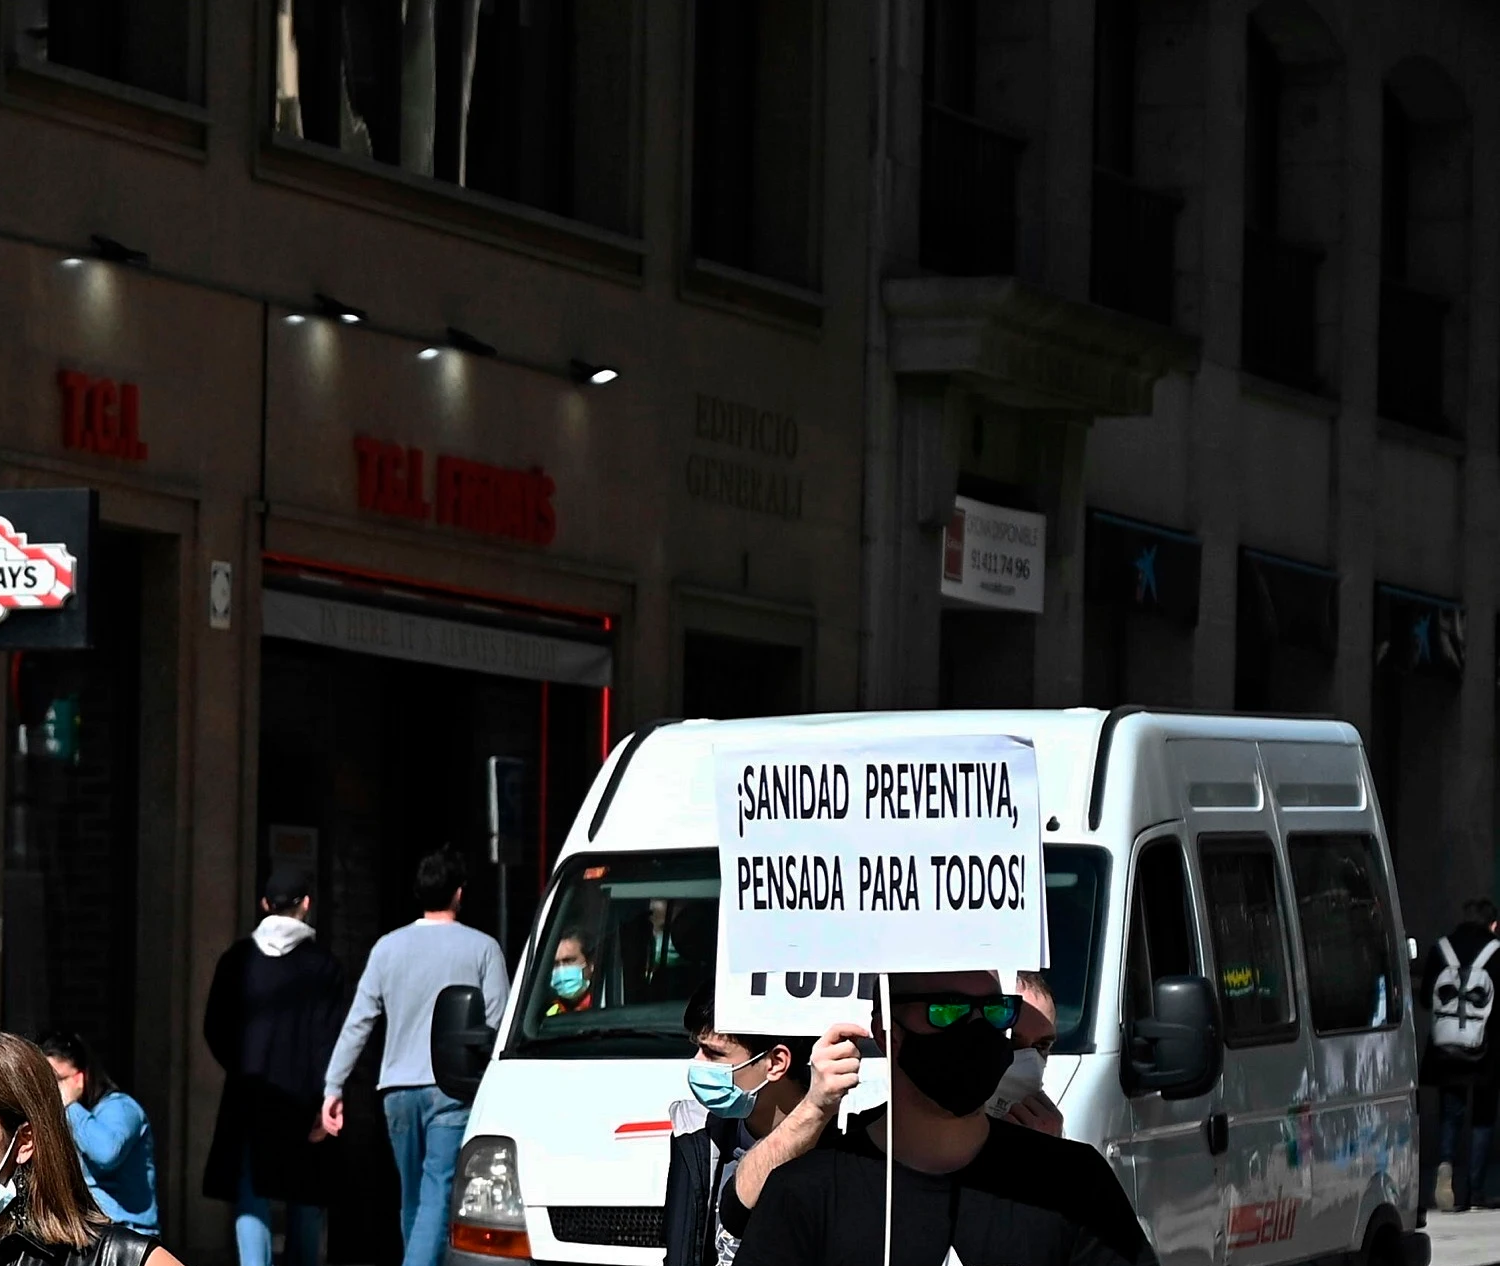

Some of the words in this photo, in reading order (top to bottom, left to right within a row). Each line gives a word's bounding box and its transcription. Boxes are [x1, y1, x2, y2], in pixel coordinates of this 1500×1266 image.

[695, 392, 798, 460] EDIFICIO
[686, 453, 803, 521] GENERALI
[738, 764, 848, 838] ¡SANIDAD
[866, 762, 1018, 828] PREVENTIVA,
[738, 856, 844, 911] PENSADA
[859, 856, 919, 911] PARA
[931, 855, 1025, 911] TODOS!
